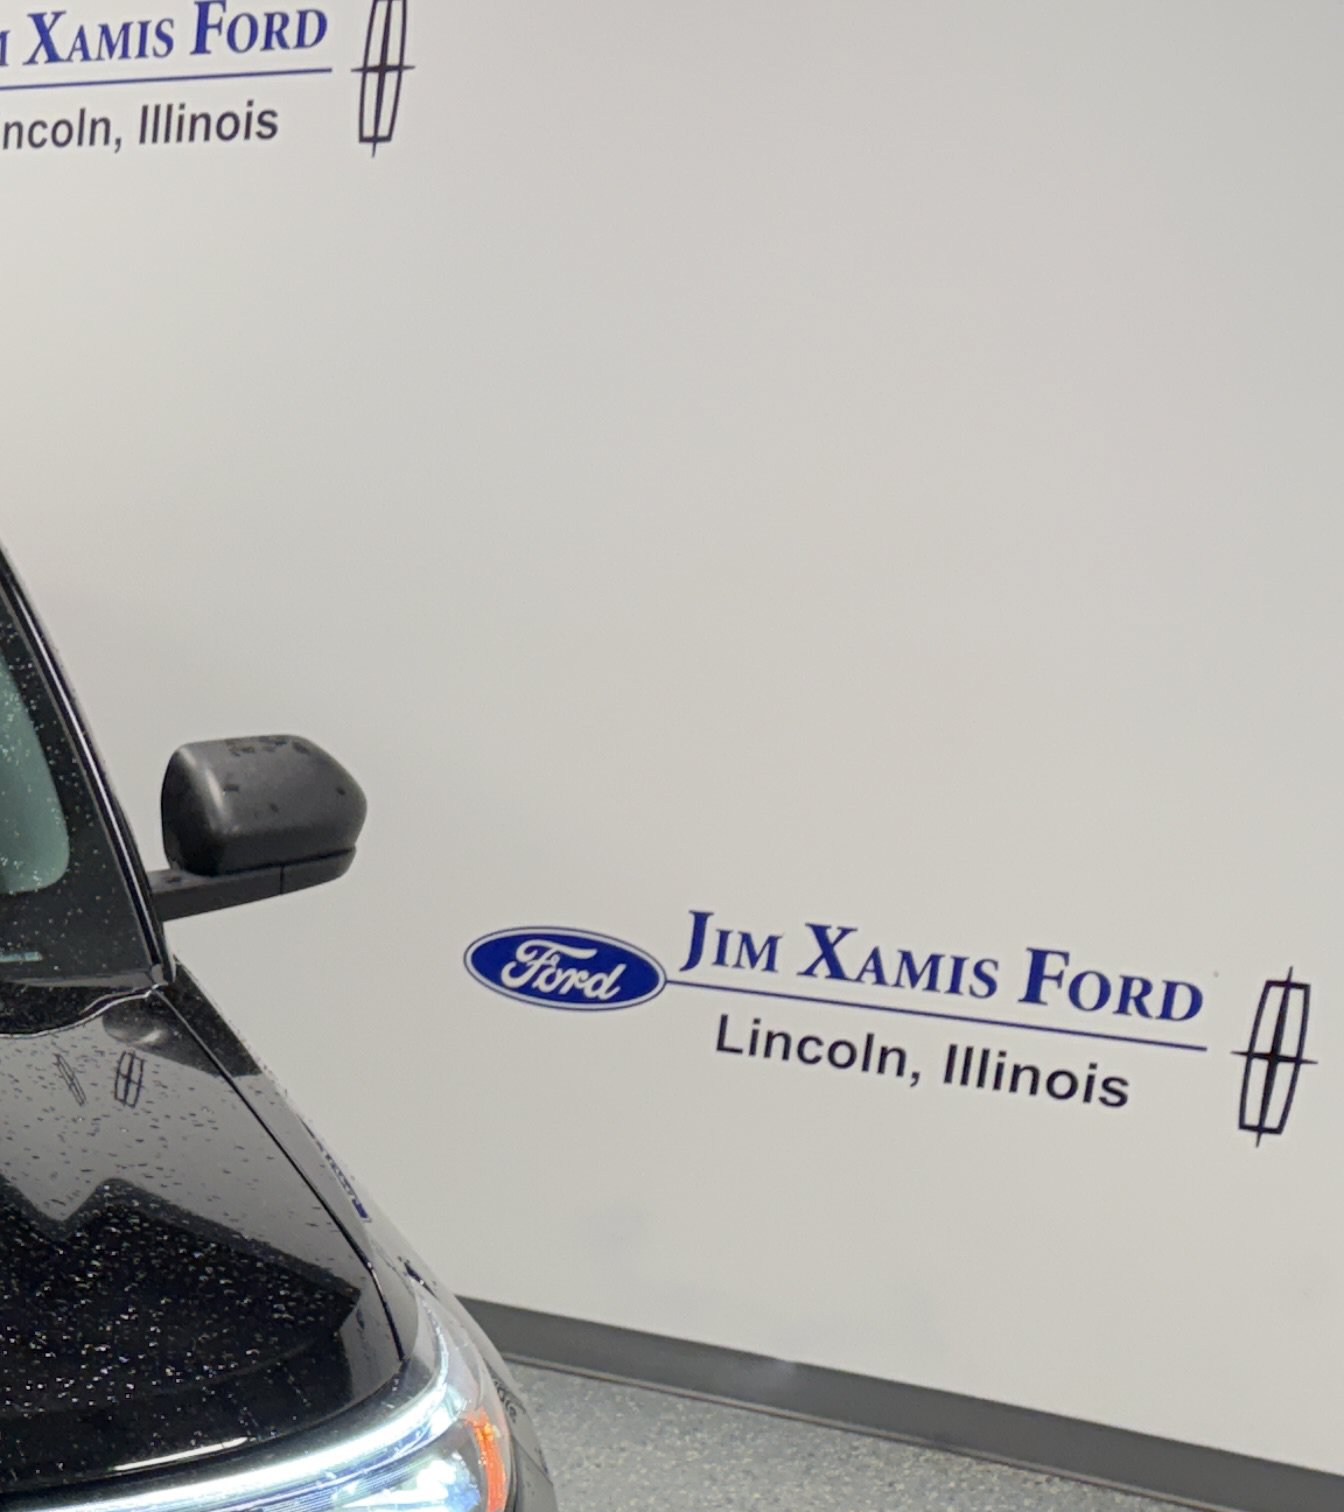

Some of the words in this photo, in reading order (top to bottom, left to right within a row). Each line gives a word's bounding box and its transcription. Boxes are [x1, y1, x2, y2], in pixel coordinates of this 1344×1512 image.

[23, 11, 173, 65] XAMIS
[190, 0, 327, 54] FORD
[140, 100, 277, 144] Illinois
[501, 939, 625, 1000] Ford
[680, 911, 781, 972] JIM
[796, 923, 998, 998] XAMIS
[1018, 948, 1202, 1021] FORD
[716, 1013, 922, 1087] Lincoln,
[944, 1044, 1128, 1107] Illinois
